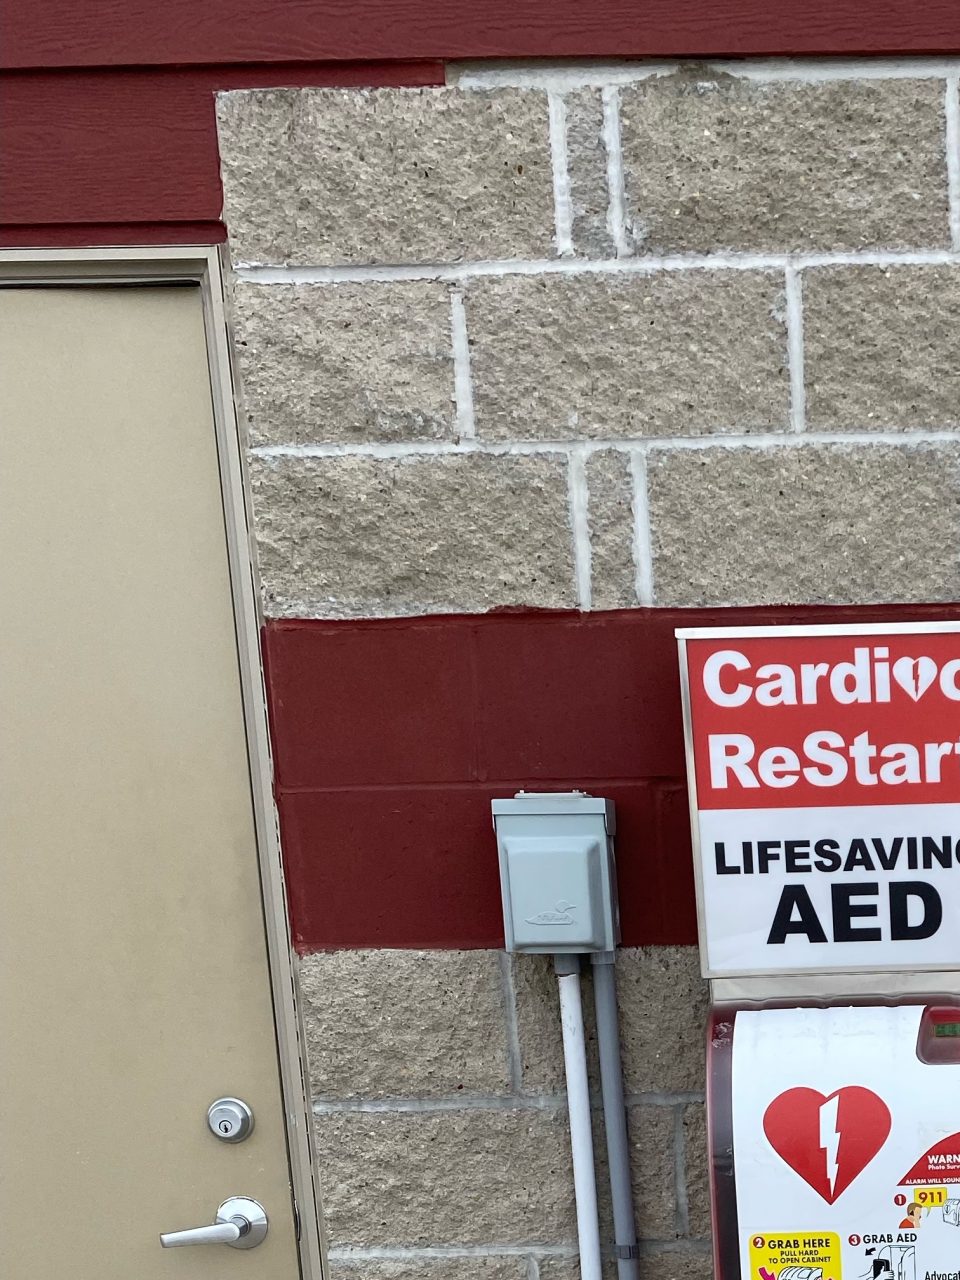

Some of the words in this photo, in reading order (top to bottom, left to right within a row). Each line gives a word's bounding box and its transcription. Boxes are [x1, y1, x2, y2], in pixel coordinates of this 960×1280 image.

[766, 881, 943, 944] AED
[919, 1192, 942, 1203] 911
[768, 1240, 799, 1249] GRAB
[803, 1239, 830, 1248] HERE
[863, 1234, 893, 1244] GRAB
[897, 1233, 917, 1243] AED
